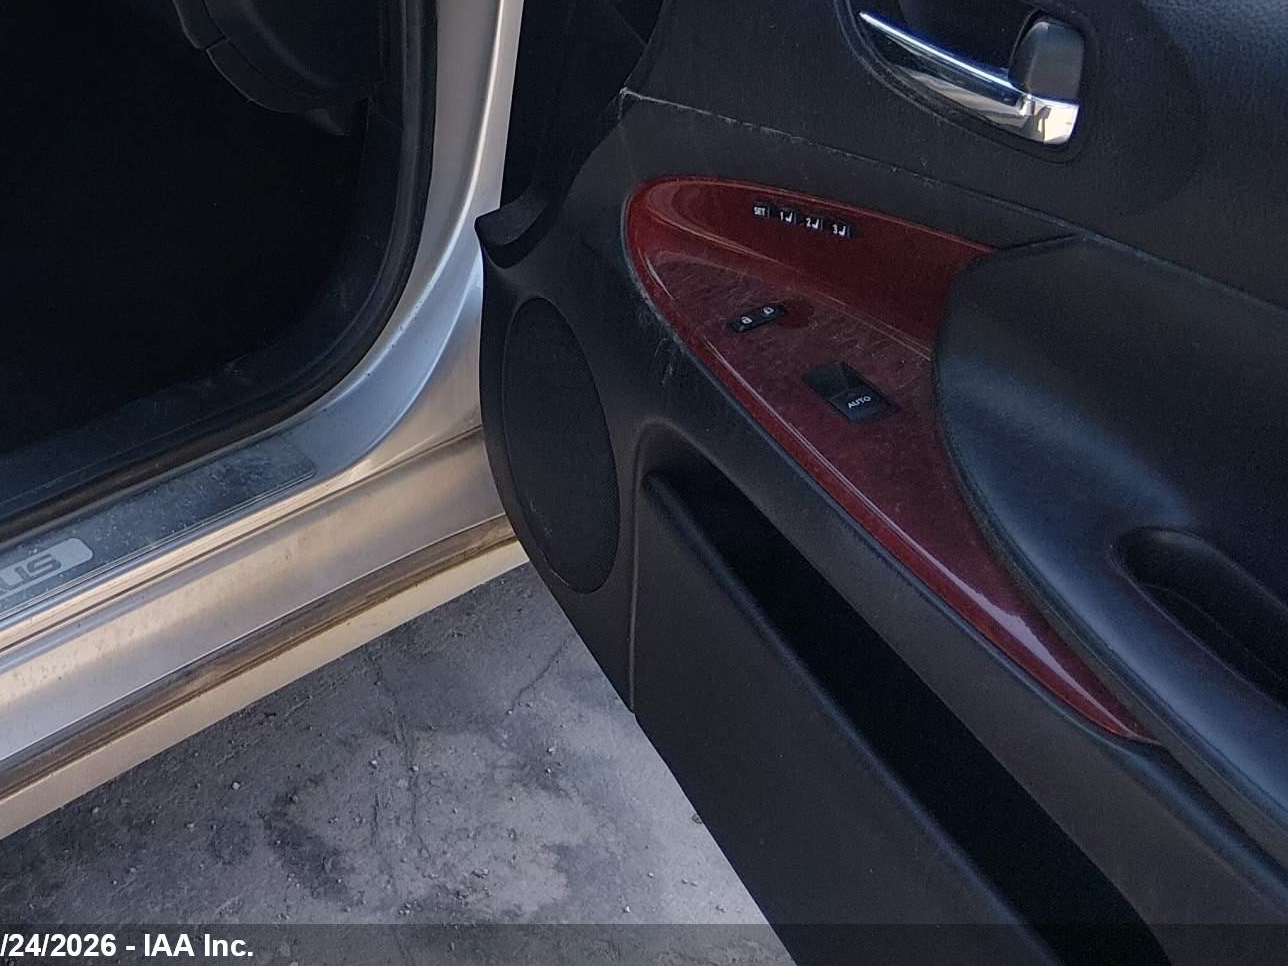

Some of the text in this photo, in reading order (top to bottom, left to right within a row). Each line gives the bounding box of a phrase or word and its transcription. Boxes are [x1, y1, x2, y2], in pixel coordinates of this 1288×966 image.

[753, 206, 838, 235] SET 1 2 3
[847, 395, 872, 409] AUTO
